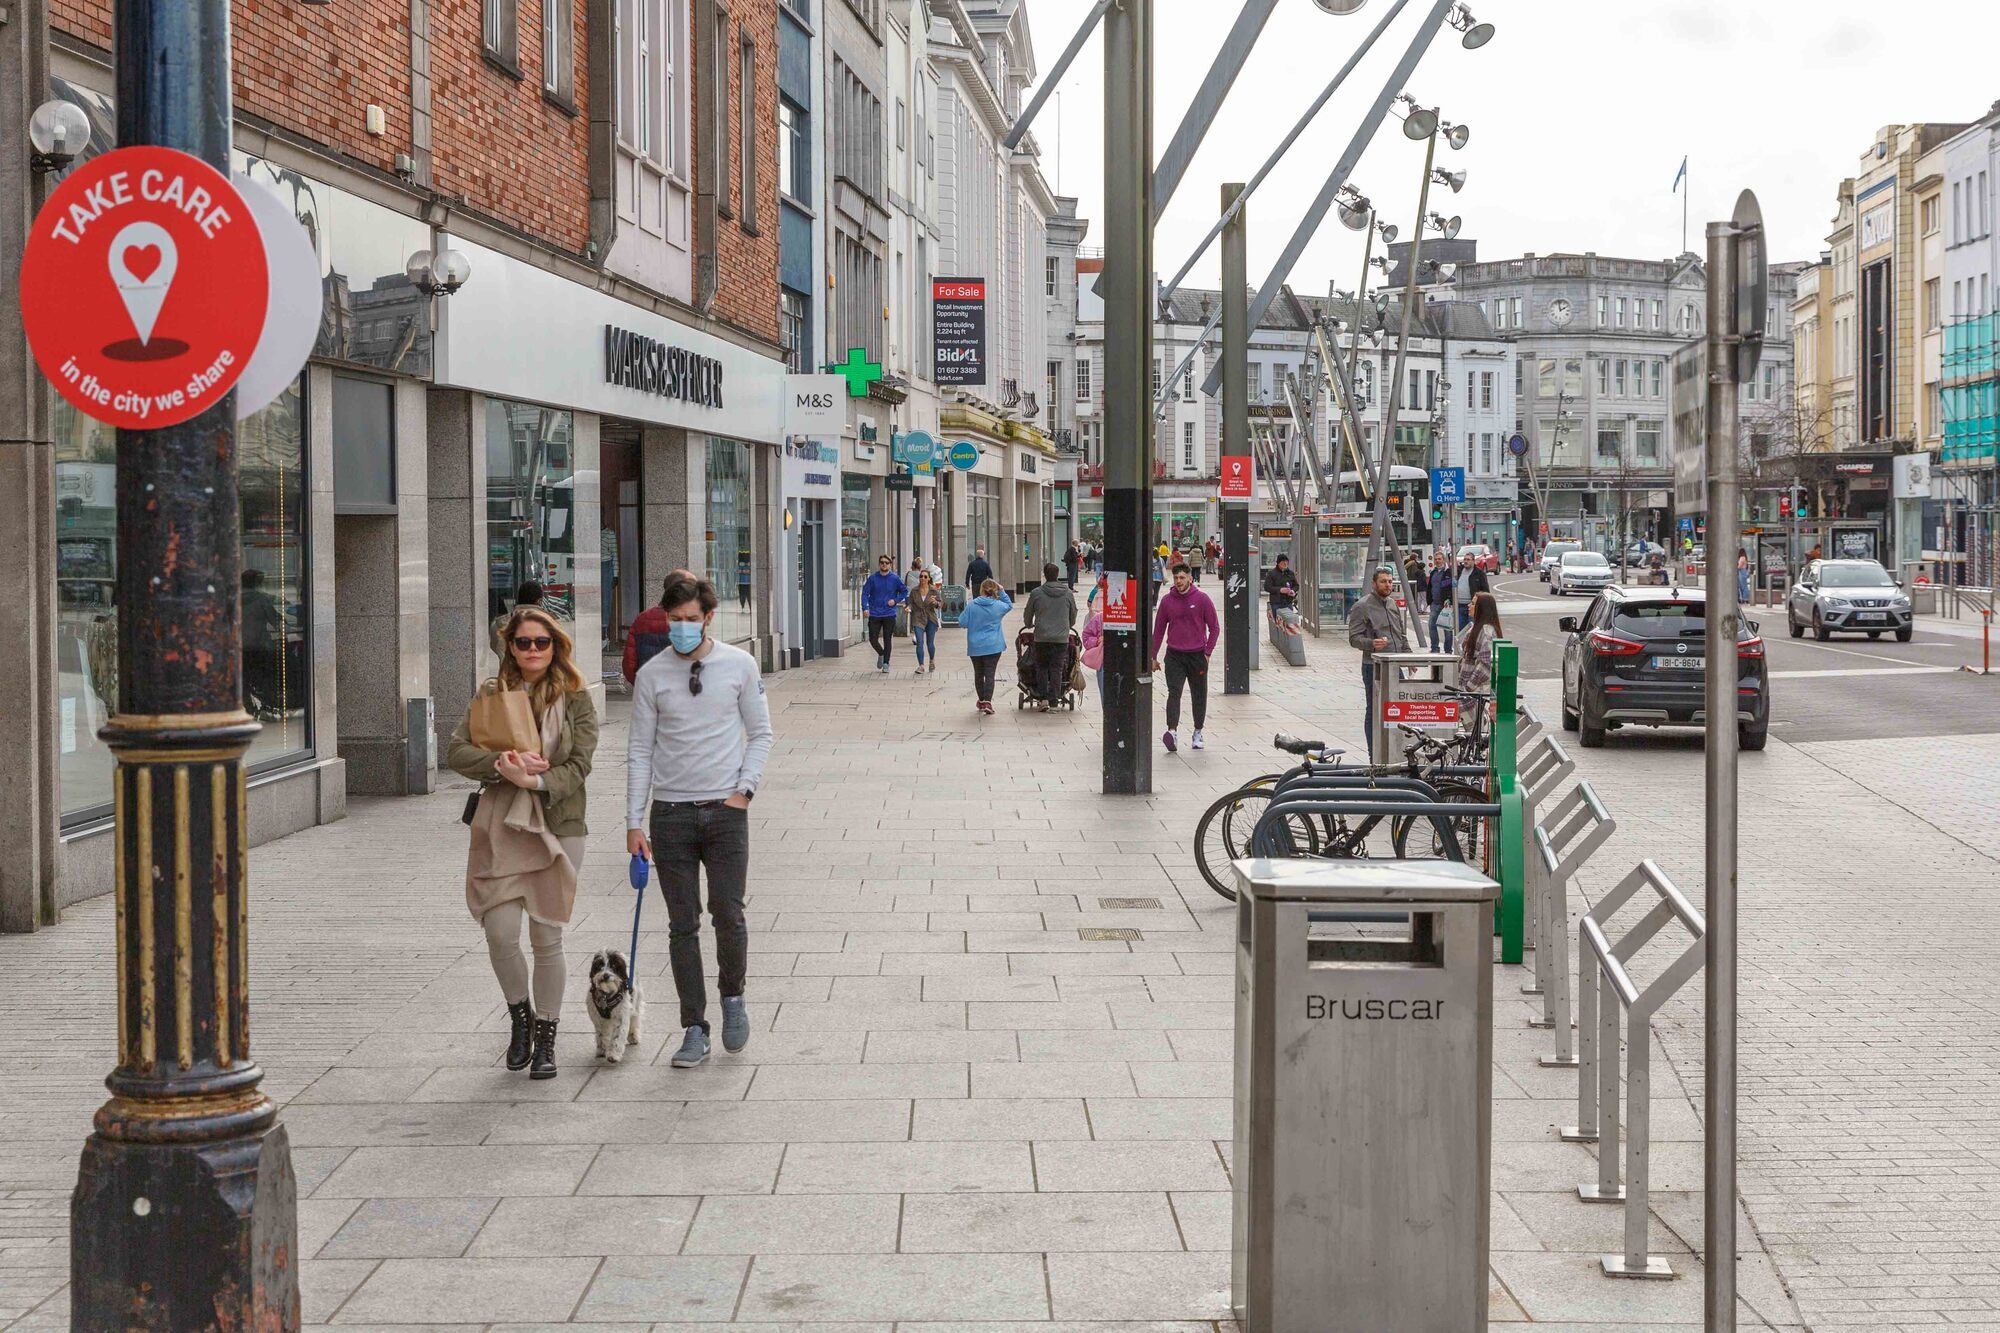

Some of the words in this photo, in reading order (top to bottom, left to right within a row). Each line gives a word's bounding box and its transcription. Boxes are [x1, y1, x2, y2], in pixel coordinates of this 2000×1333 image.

[51, 171, 134, 245] TAKE
[140, 169, 232, 240] CARE
[939, 286, 956, 297] For
[958, 286, 980, 297] Sale
[60, 356, 81, 383] in
[79, 374, 111, 405] the
[113, 390, 151, 419] city
[154, 389, 185, 411] we
[186, 350, 235, 398] share
[796, 393, 833, 408] M&S
[1438, 470, 1457, 478] TAXI
[1320, 544, 1347, 554] TOP
[1662, 658, 1701, 667] 181-C-8604
[1398, 691, 1442, 700] Bruscar
[1307, 995, 1444, 1019] Bruscar
